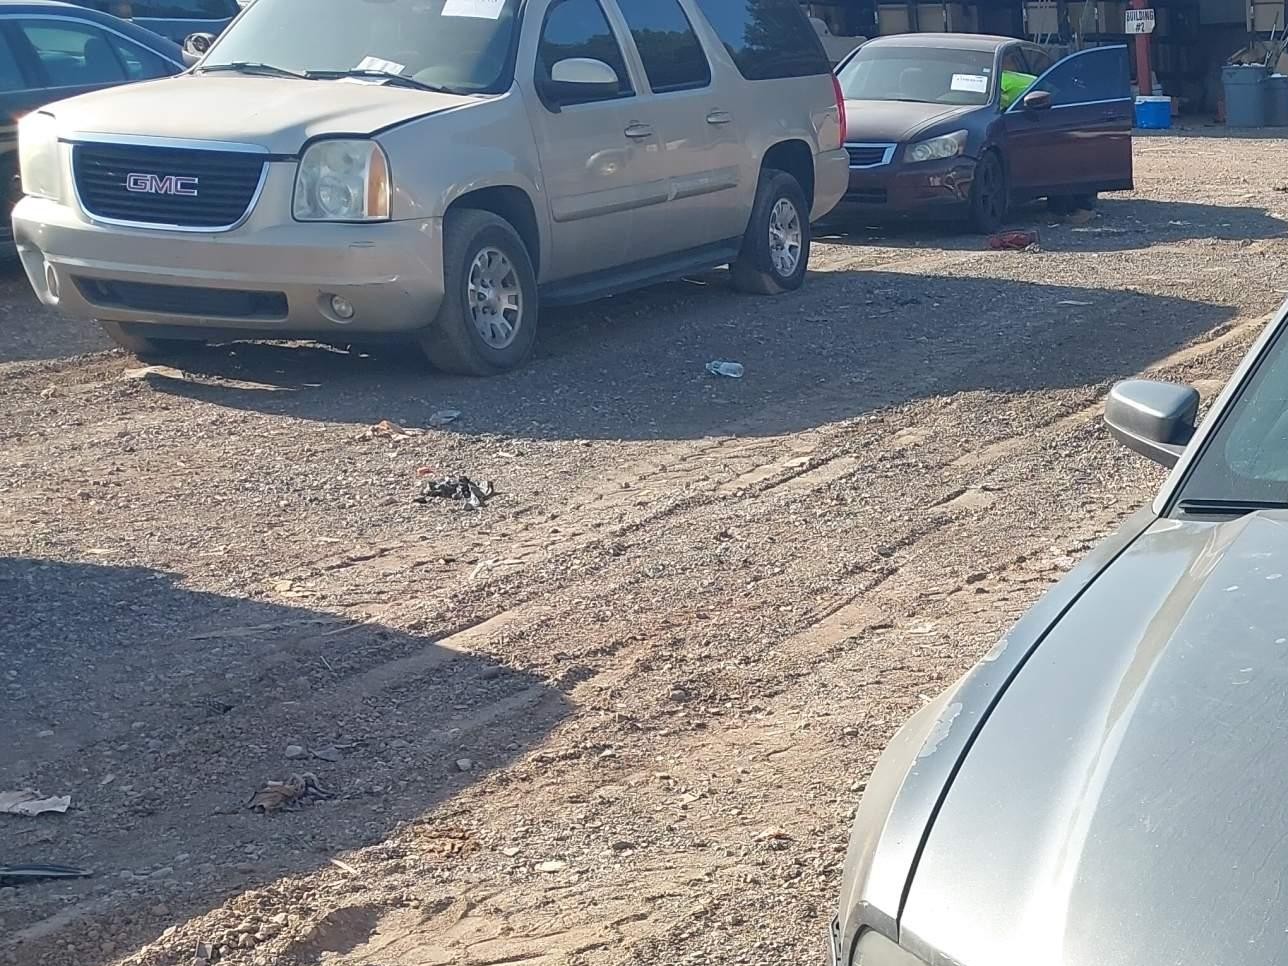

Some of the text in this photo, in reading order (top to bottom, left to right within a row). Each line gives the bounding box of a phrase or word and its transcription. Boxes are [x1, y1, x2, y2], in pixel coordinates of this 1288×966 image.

[1126, 10, 1154, 21] BUILDING
[1136, 22, 1145, 32] #2
[127, 172, 198, 196] GMC
